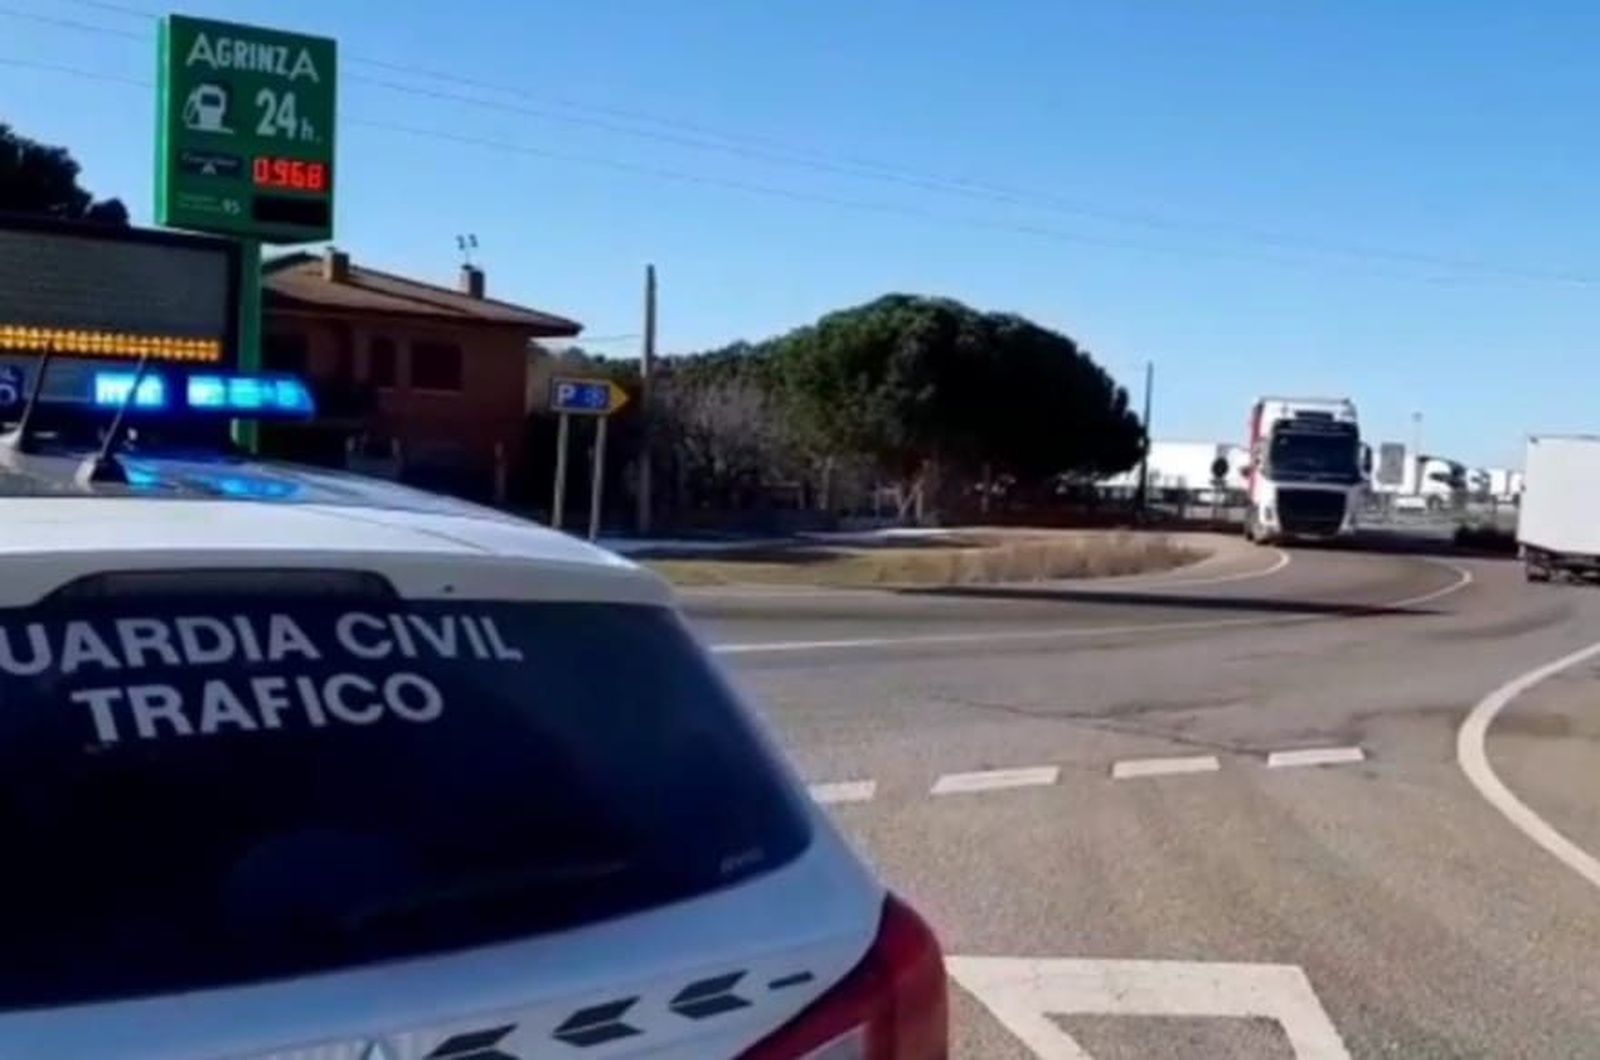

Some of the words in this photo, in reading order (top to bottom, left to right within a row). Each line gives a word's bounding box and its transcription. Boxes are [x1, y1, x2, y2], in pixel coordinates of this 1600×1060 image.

[186, 32, 320, 82] AGRINZA
[255, 88, 297, 140] 24
[557, 383, 576, 405] P
[336, 612, 524, 662] CIVIL
[71, 673, 443, 742] TRAFICO
